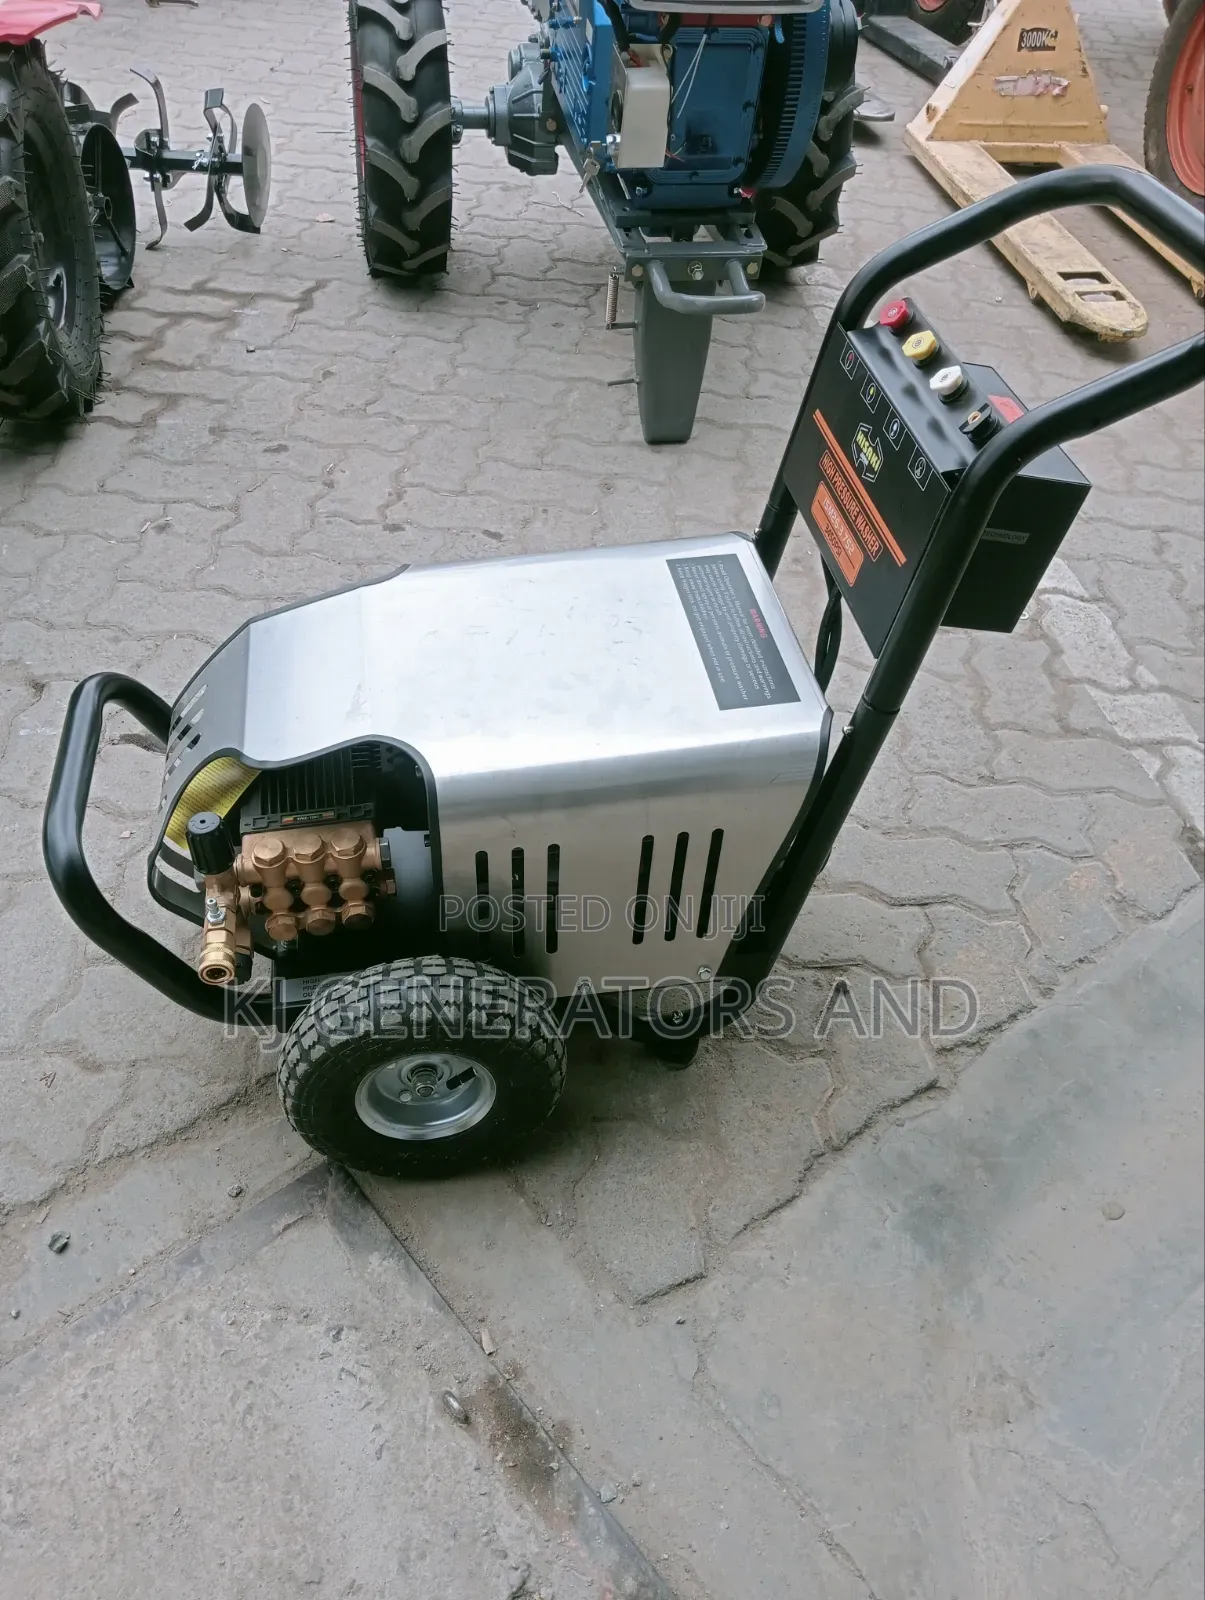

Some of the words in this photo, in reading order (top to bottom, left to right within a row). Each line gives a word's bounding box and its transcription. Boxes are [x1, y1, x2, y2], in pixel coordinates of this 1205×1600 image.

[856, 429, 880, 472] HISAKI
[822, 453, 835, 477] HIGH
[831, 474, 859, 518] PRESSURE
[855, 515, 879, 556] WASHER
[750, 608, 768, 638] WARNING
